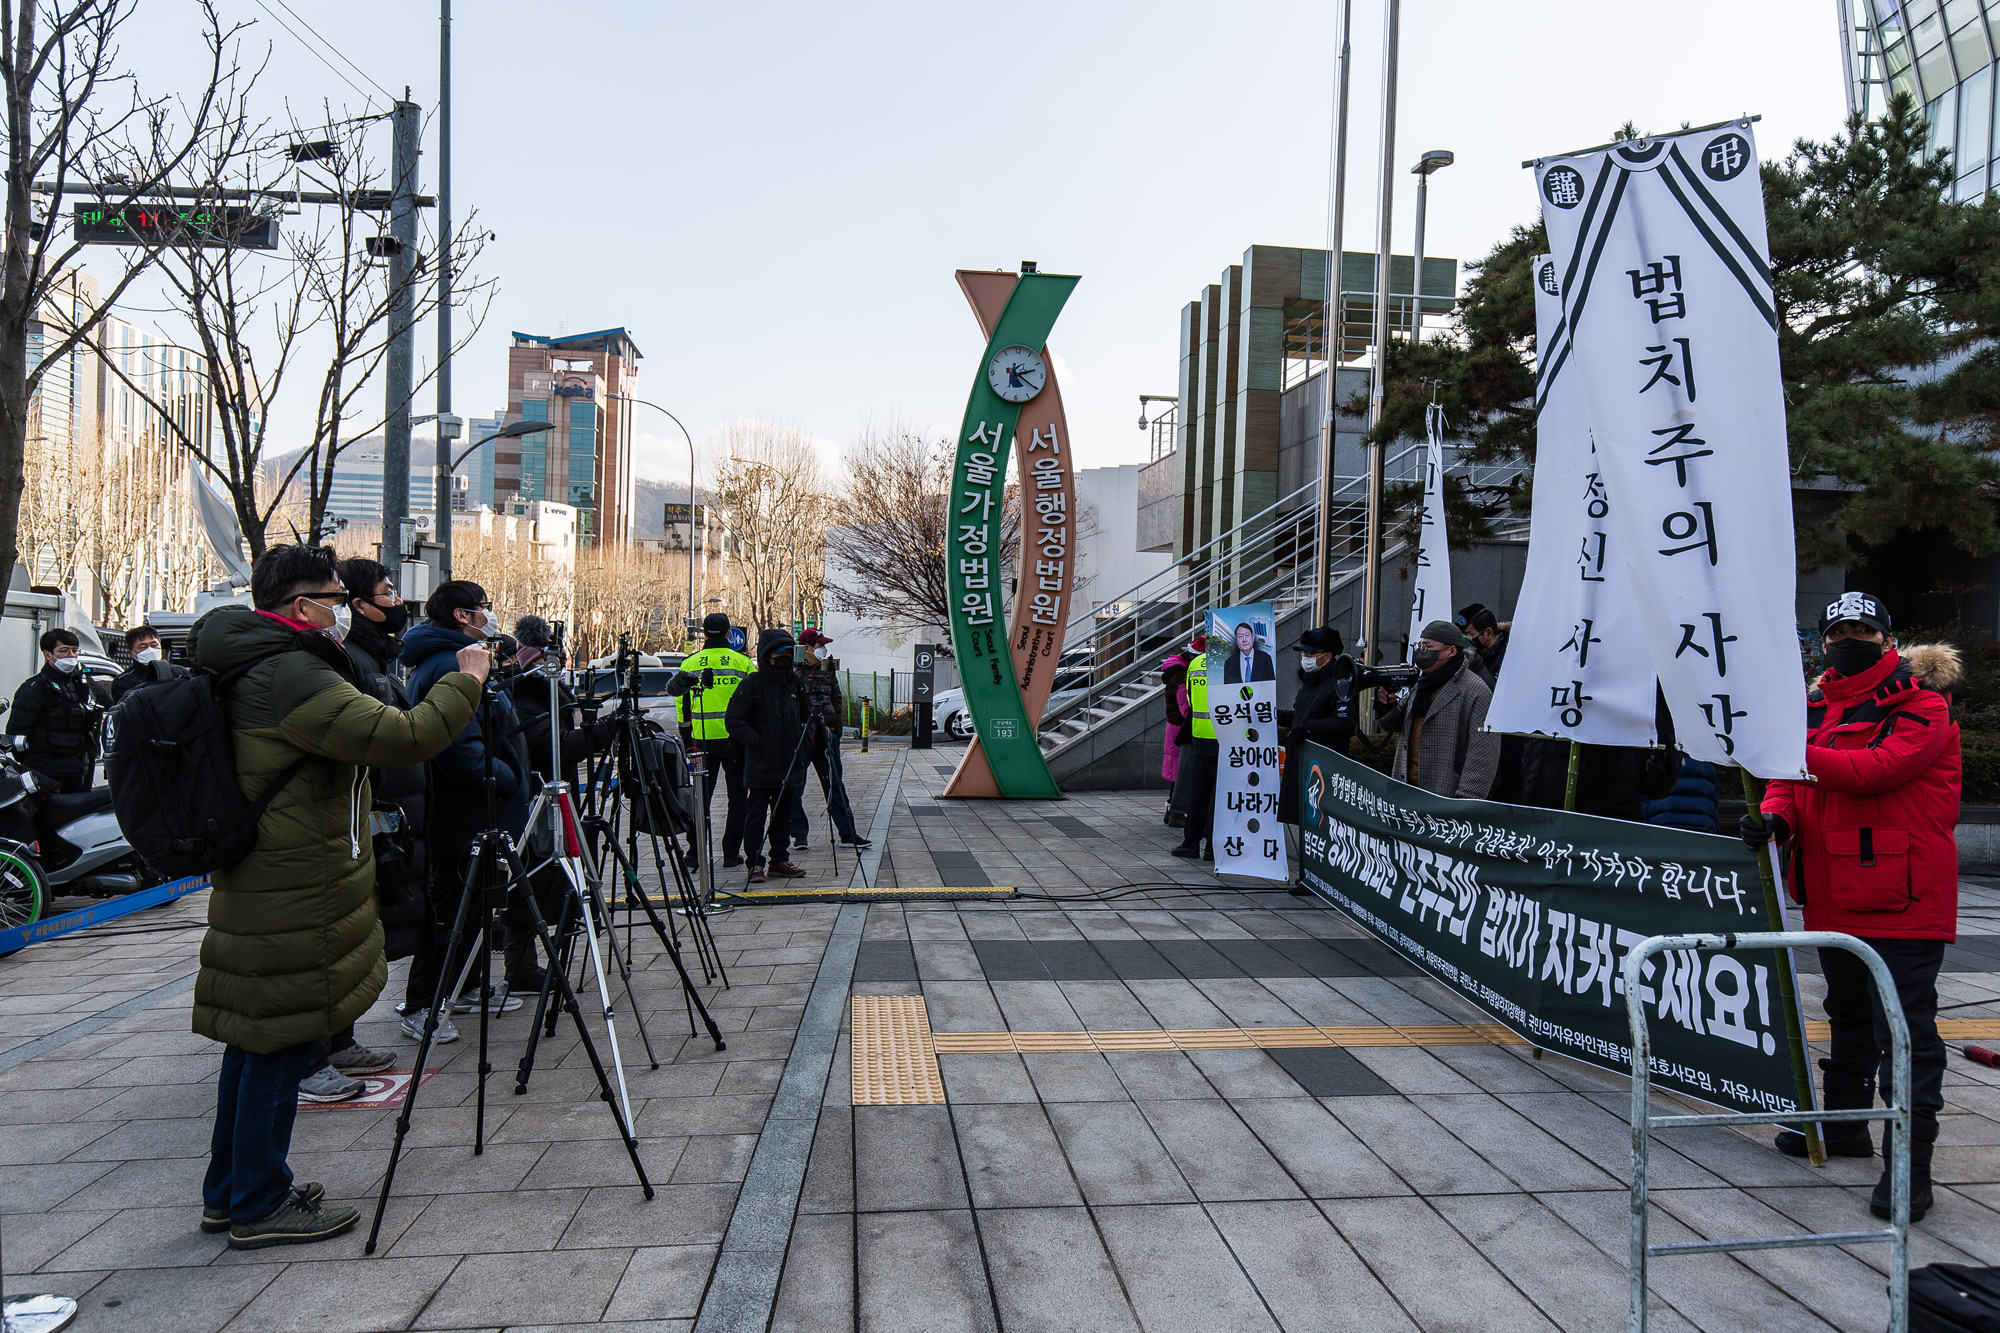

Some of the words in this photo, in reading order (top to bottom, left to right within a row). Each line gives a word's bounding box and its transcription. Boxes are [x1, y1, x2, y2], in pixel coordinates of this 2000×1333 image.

[1708, 136, 1743, 176] 弔
[1549, 171, 1579, 205] 謹
[554, 384, 594, 398] koita
[957, 420, 1004, 626] 서울가정법원
[1625, 255, 1717, 567] 법치주의
[1675, 612, 1748, 757] 사망
[1028, 423, 1066, 626] 서울행정법원
[1827, 599, 1876, 620] GZSS
[971, 631, 983, 657] Court
[1017, 625, 1030, 650] Seoul
[1041, 630, 1055, 657] Court
[984, 629, 996, 654] Seoul
[990, 658, 1002, 685] Family
[1020, 628, 1043, 691] Administrative
[1550, 618, 1602, 728] 사망
[1214, 701, 1277, 726] 윤석열
[997, 729, 1012, 737] 193
[1228, 746, 1277, 768] 살아야
[1227, 791, 1278, 815] 나라가
[1304, 829, 1327, 861] 법무부
[1331, 773, 1357, 806] 행정법원
[1423, 813, 1474, 849] 바로잡아
[1537, 839, 1574, 877] 임기
[1580, 848, 1654, 894] 지켜야
[1659, 861, 1758, 916] 합니다.
[1328, 815, 1361, 879] 정치가
[1480, 884, 1541, 980] 법치가
[1541, 908, 1776, 1057] 지켜주세요!
[1528, 1013, 1718, 1095] 국민의자유와인권을위변호사모임,
